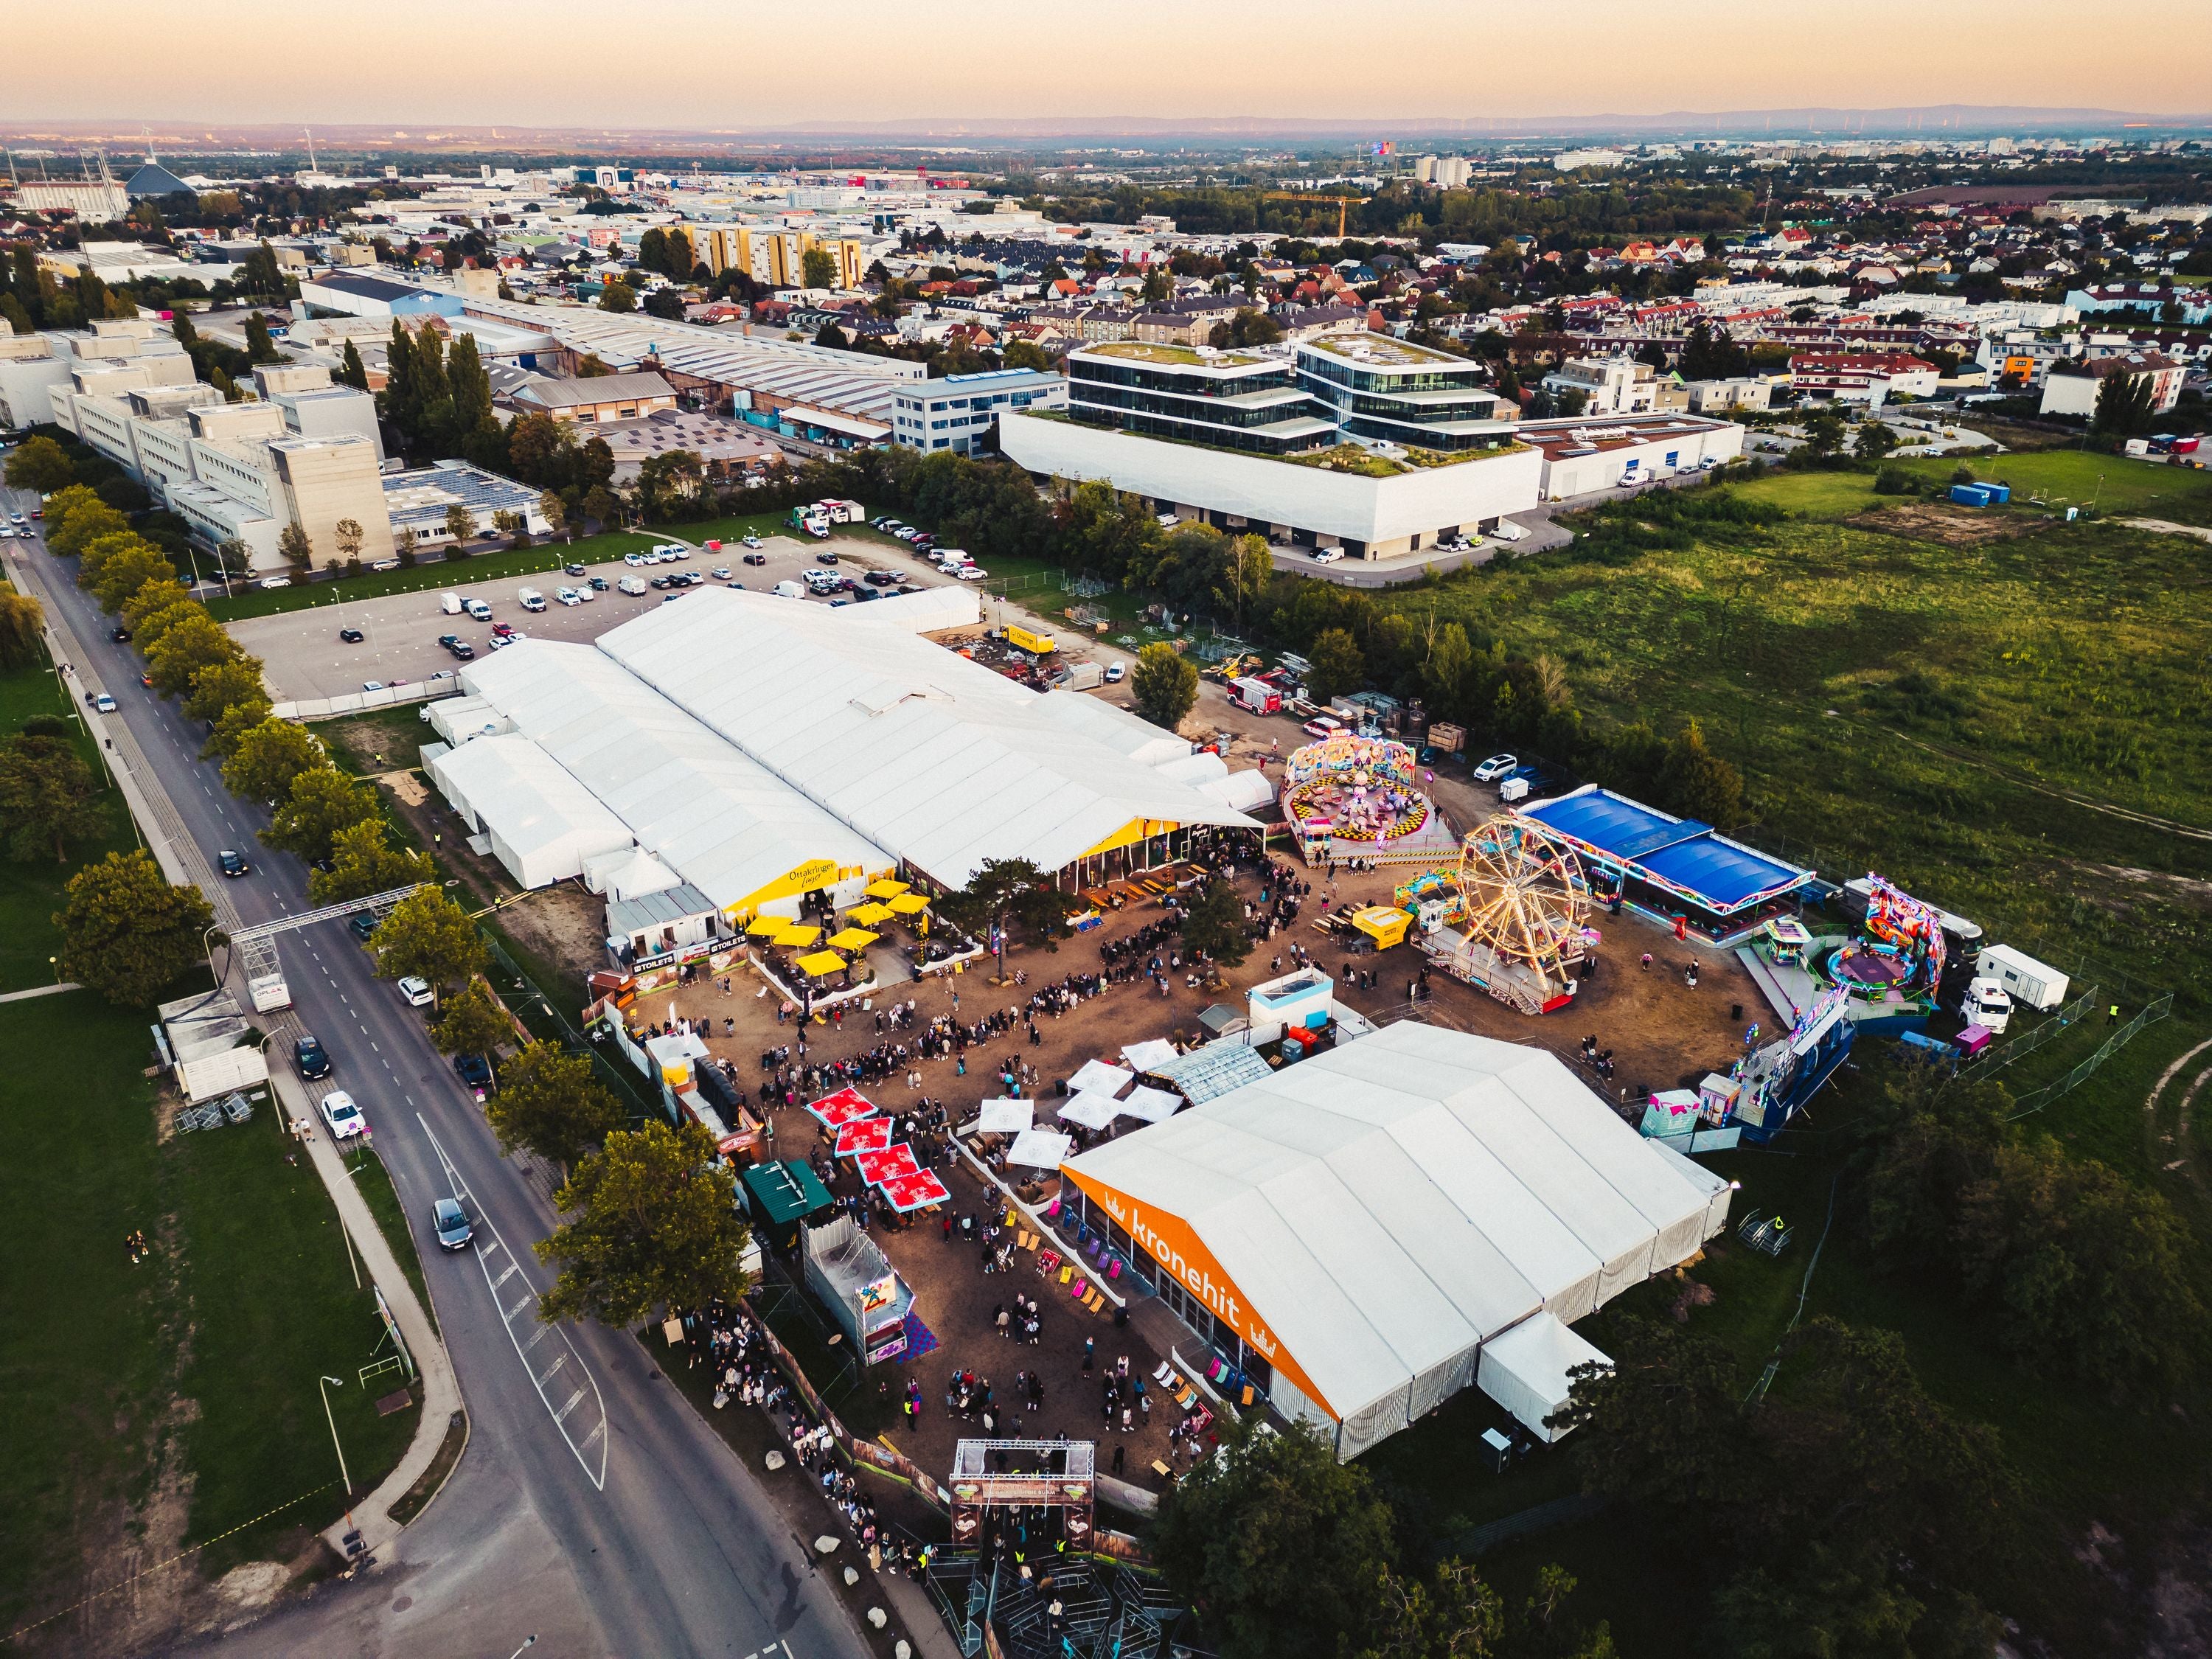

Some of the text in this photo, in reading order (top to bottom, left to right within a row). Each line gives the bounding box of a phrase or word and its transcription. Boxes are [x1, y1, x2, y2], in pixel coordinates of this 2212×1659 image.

[789, 863, 834, 880] Ottakringer
[1591, 867, 1612, 880] TICKET
[717, 935, 746, 950] TOILETS
[641, 956, 673, 971] TOILETS
[1132, 1208, 1240, 1327] kronehit
